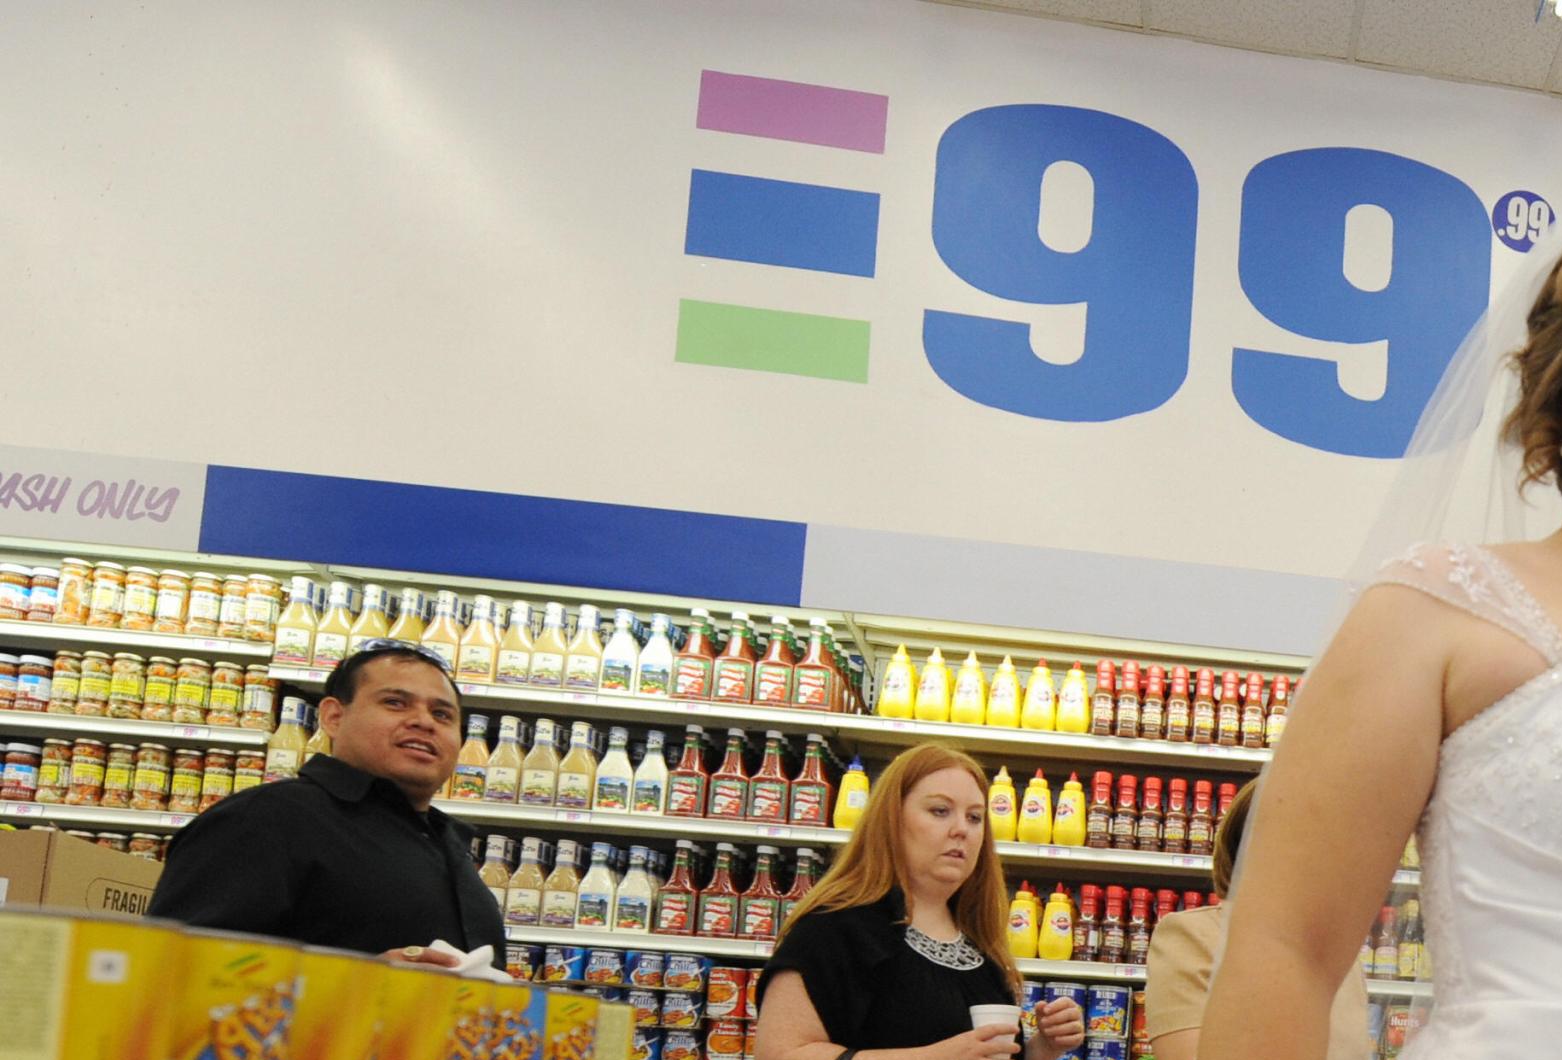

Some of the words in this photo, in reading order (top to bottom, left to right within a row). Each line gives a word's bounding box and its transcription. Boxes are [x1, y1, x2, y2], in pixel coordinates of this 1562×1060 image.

[922, 103, 1493, 459] 99
[1497, 197, 1550, 243] .99
[0, 472, 72, 513] ASH
[77, 479, 180, 522] ONLY
[102, 887, 149, 916] FRAGIL
